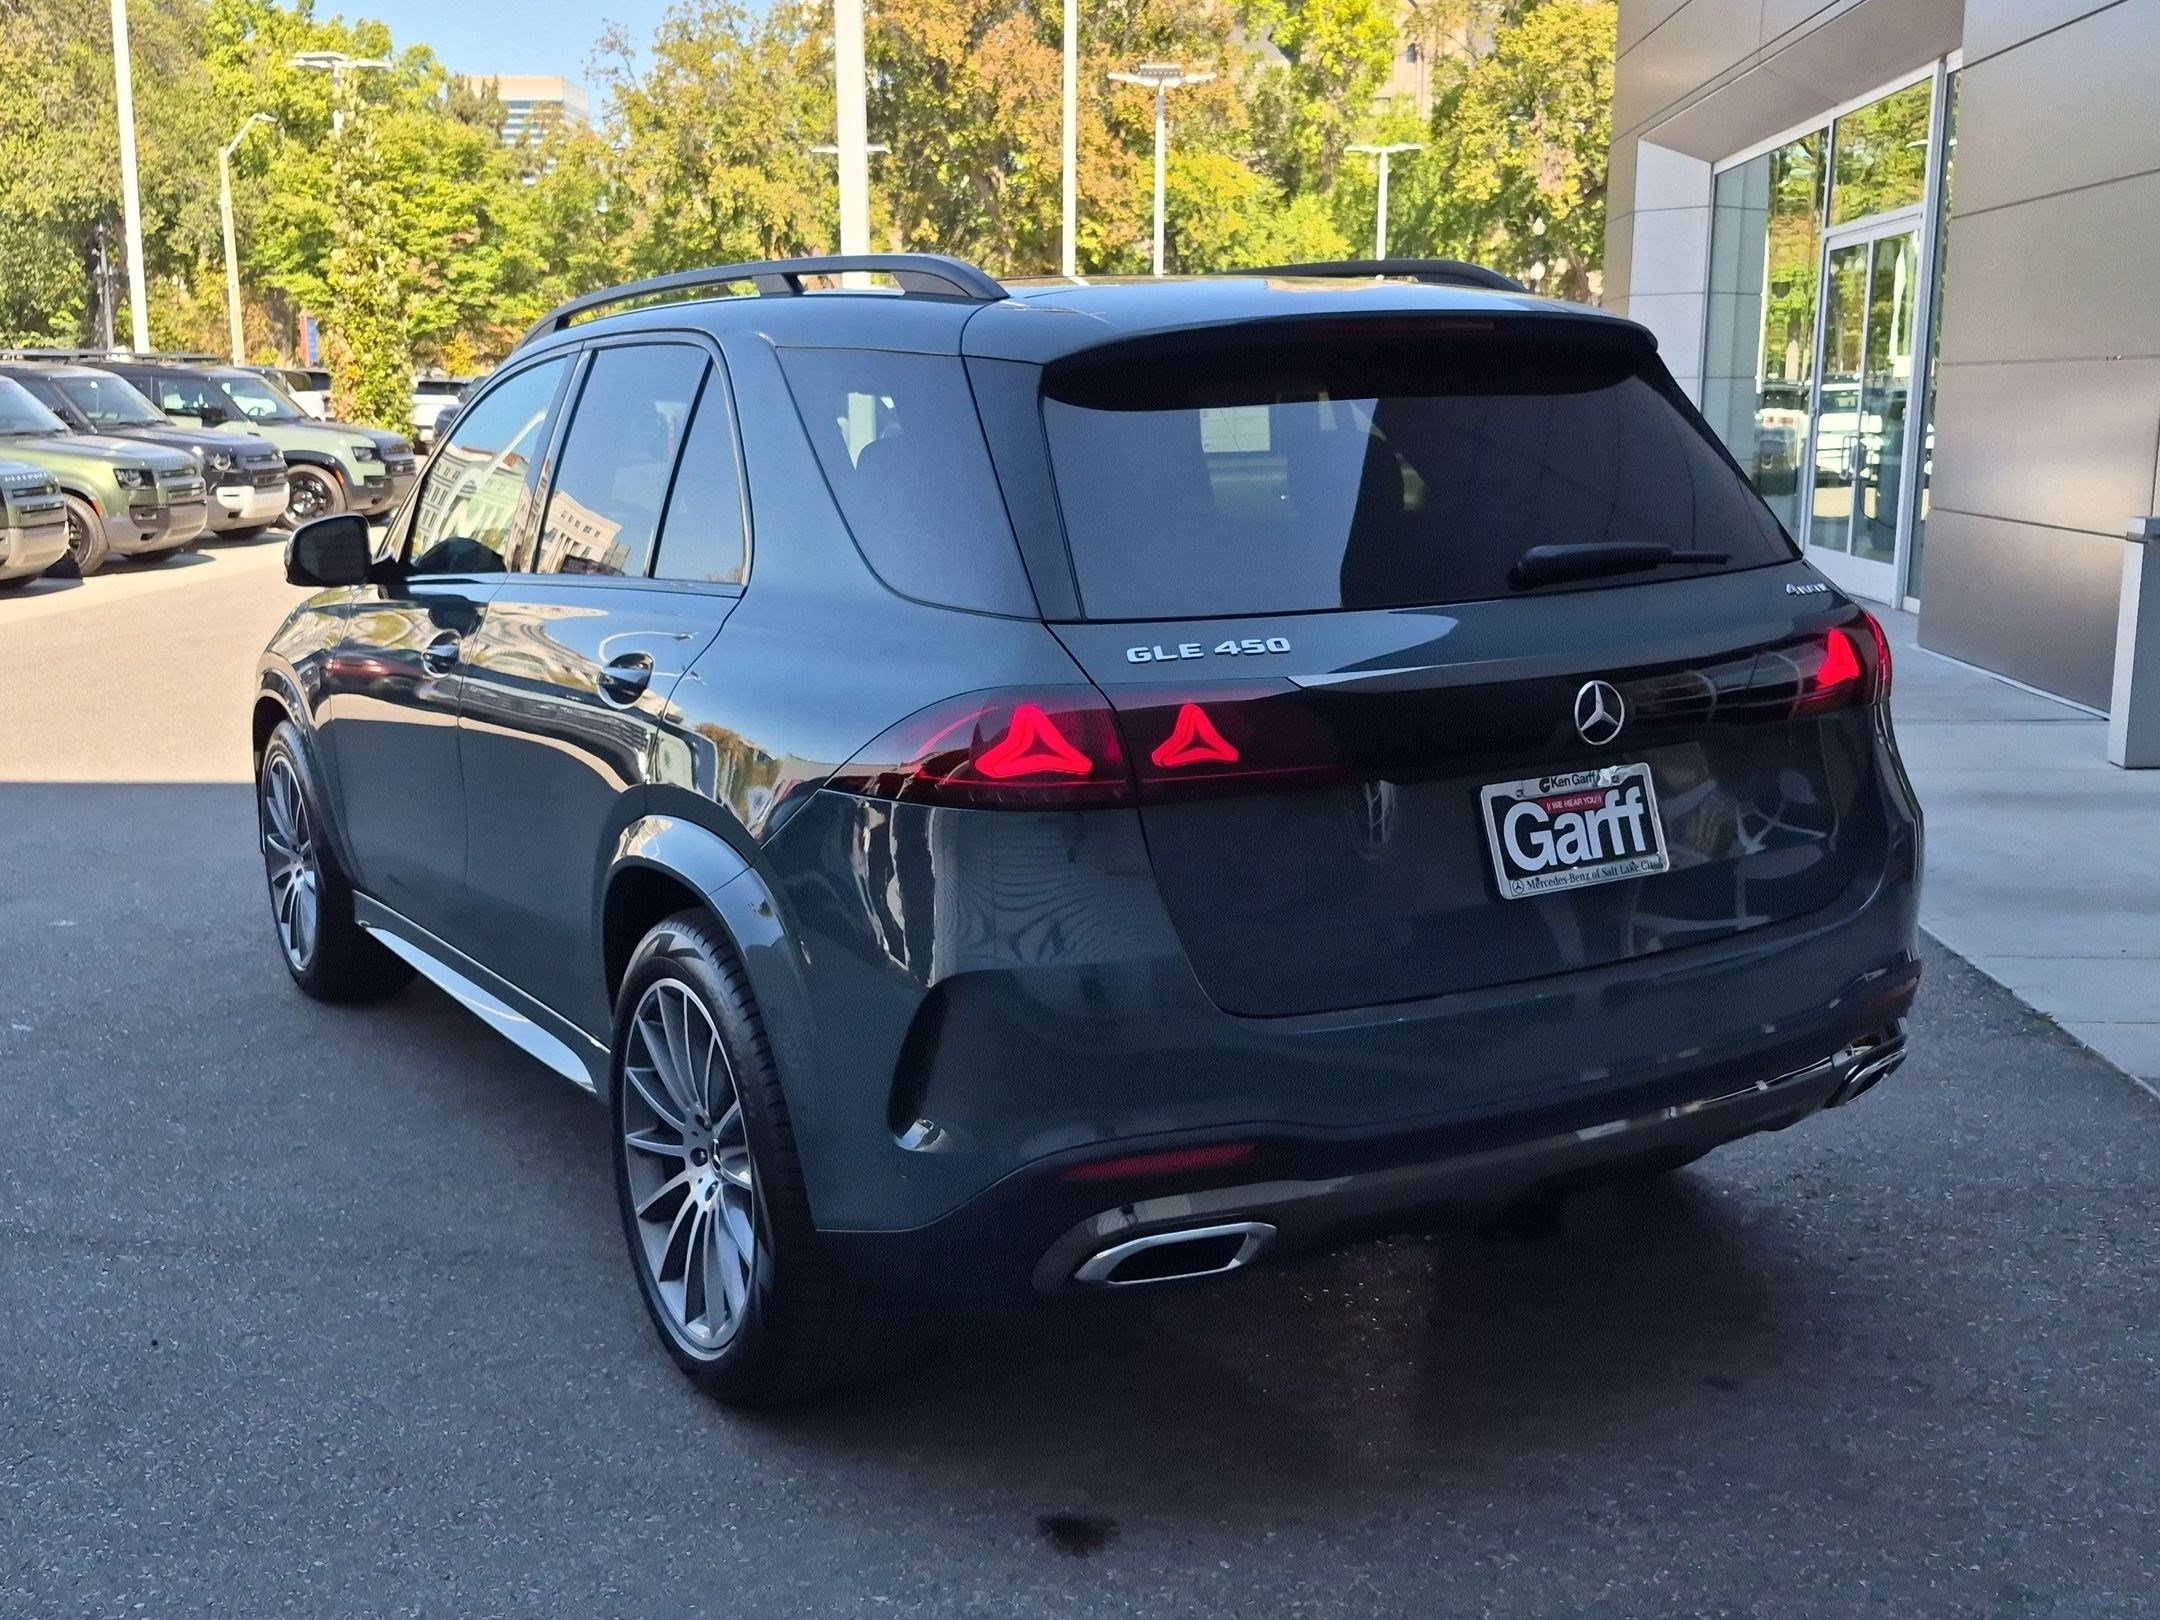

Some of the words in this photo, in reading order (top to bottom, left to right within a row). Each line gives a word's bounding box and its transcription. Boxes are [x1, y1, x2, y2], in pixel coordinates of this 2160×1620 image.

[1126, 643, 1205, 664] GLE
[1214, 637, 1292, 656] 450
[1551, 776, 1571, 788] Ken
[1571, 771, 1596, 785] Garff
[1551, 801, 1564, 810] WE
[1563, 797, 1583, 808] HEAR
[1582, 795, 1598, 805] YOU
[1503, 786, 1647, 872] Garff
[1526, 872, 1591, 891] Mercedes-Benz
[1591, 868, 1601, 879] of
[1601, 864, 1620, 877] Salt
[1619, 861, 1640, 874] Lake
